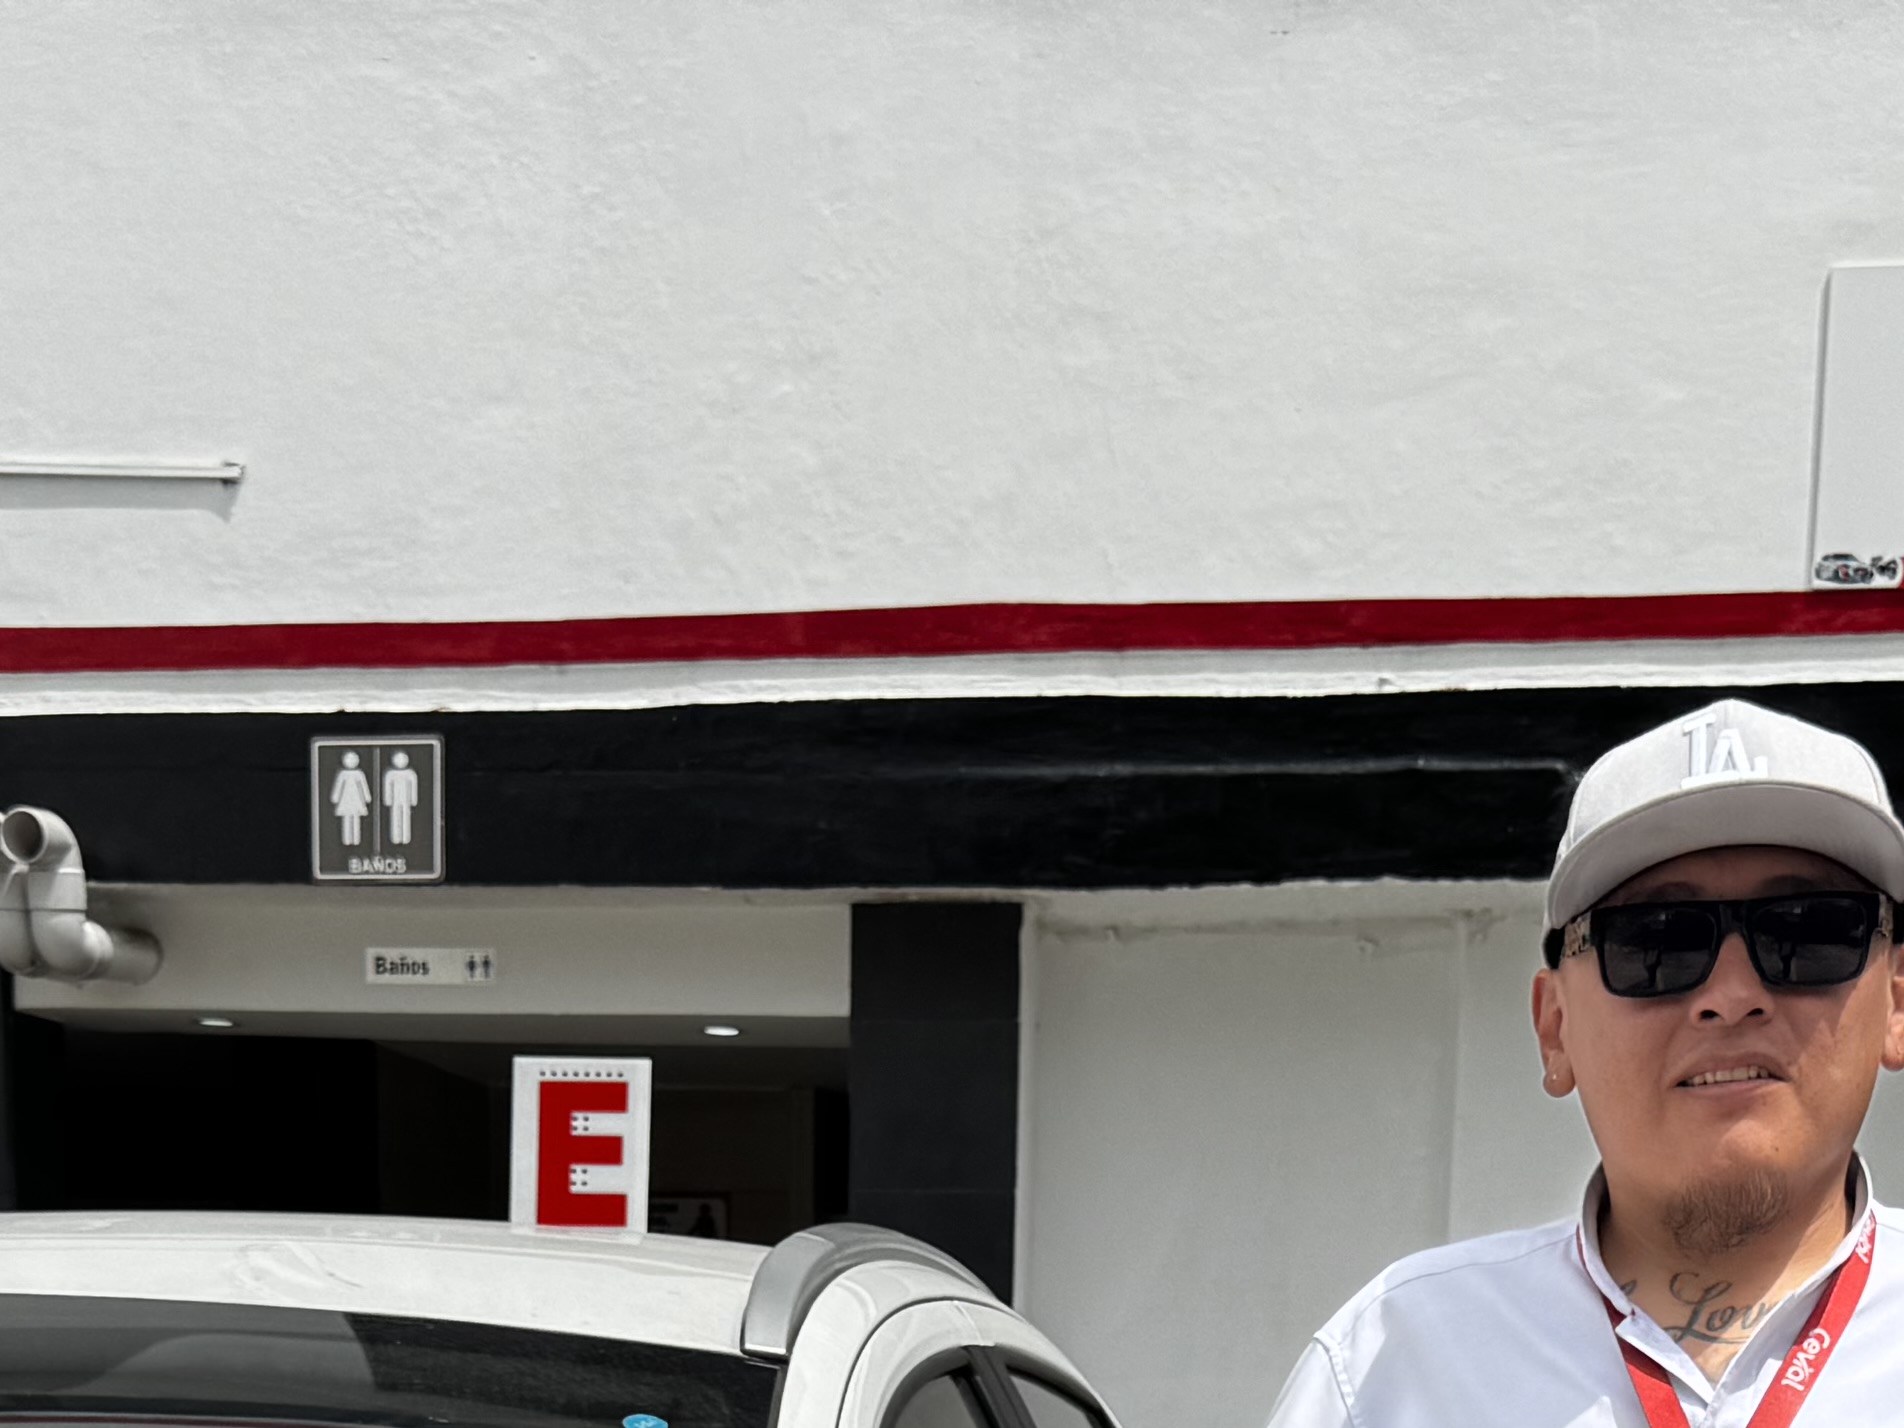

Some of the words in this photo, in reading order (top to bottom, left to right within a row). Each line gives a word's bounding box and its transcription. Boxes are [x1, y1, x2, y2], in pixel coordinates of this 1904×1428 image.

[1680, 712, 1769, 789] LA
[348, 856, 407, 874] BAÑOS
[374, 956, 430, 976] Baños
[536, 1080, 629, 1227] E
[1780, 1328, 1831, 1391] Cevial
